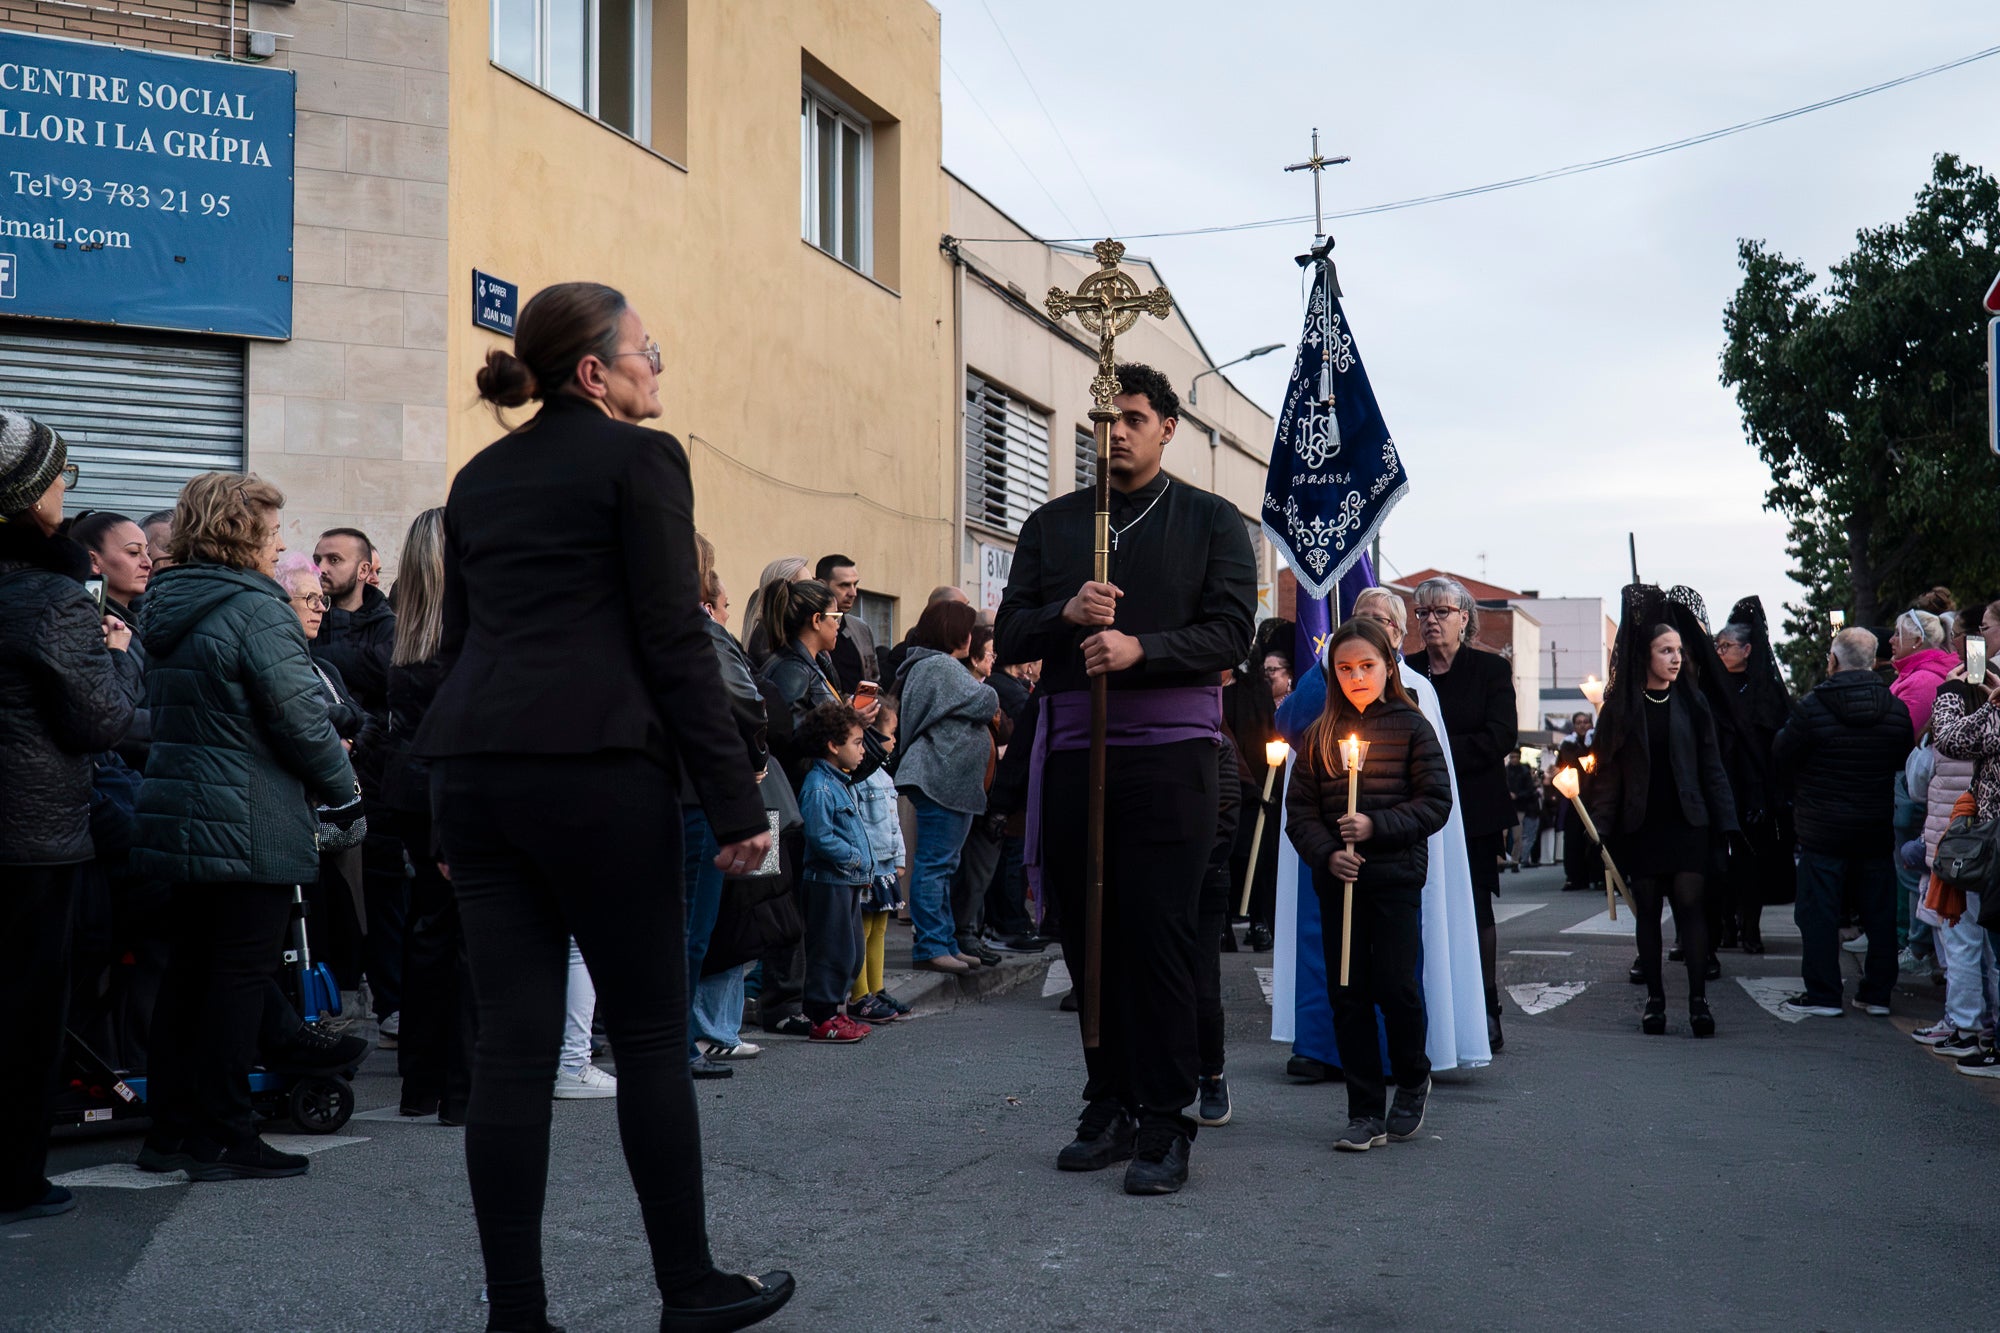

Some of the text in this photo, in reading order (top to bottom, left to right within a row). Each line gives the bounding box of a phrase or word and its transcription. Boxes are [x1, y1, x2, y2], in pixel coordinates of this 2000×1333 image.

[0, 63, 255, 120] CENTRE SOCIAL
[94, 121, 107, 147] I
[114, 123, 157, 154] LA
[163, 128, 272, 167] GRÍPIA
[9, 171, 231, 217] Tel 93 783 21 95
[483, 307, 499, 322] JOAN
